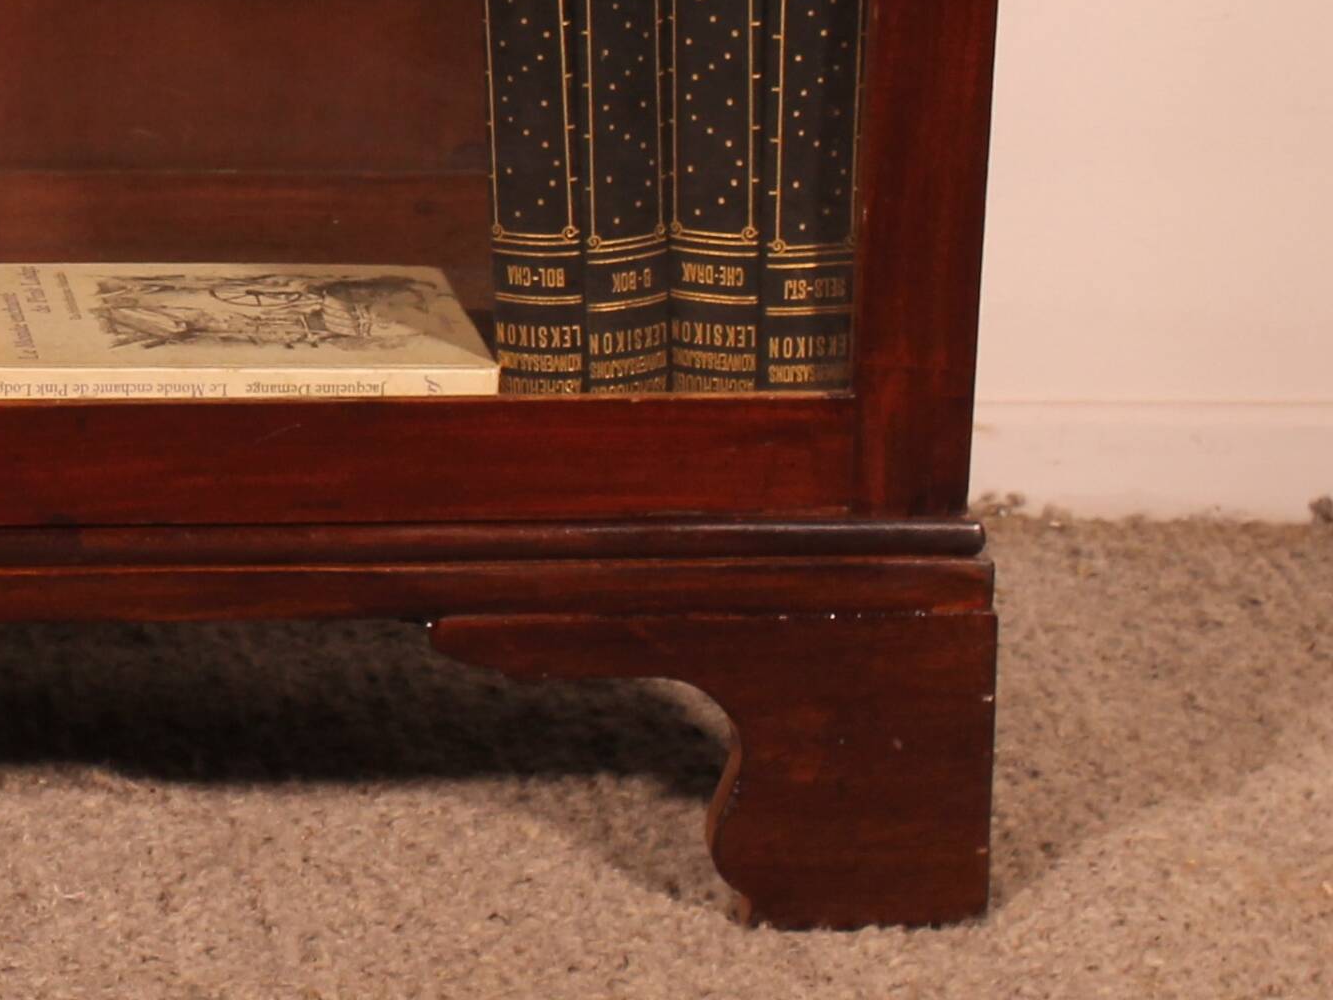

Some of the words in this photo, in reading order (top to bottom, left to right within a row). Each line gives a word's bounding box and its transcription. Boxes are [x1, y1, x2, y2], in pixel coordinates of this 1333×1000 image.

[506, 265, 566, 288] BOL-CHA
[612, 267, 653, 293] B-BOK
[681, 261, 745, 287] CHE-DRAK
[496, 322, 582, 348] LEKSIKON
[589, 320, 667, 355] LEKSIKON
[670, 319, 757, 348] LEKSIKON
[36, 382, 68, 397] Pink
[72, 381, 90, 395] de
[92, 381, 154, 396] enchanté
[156, 381, 205, 397] Monde
[209, 383, 228, 397] Le
[245, 381, 312, 396] Demange
[314, 379, 387, 397] Jacqueline
